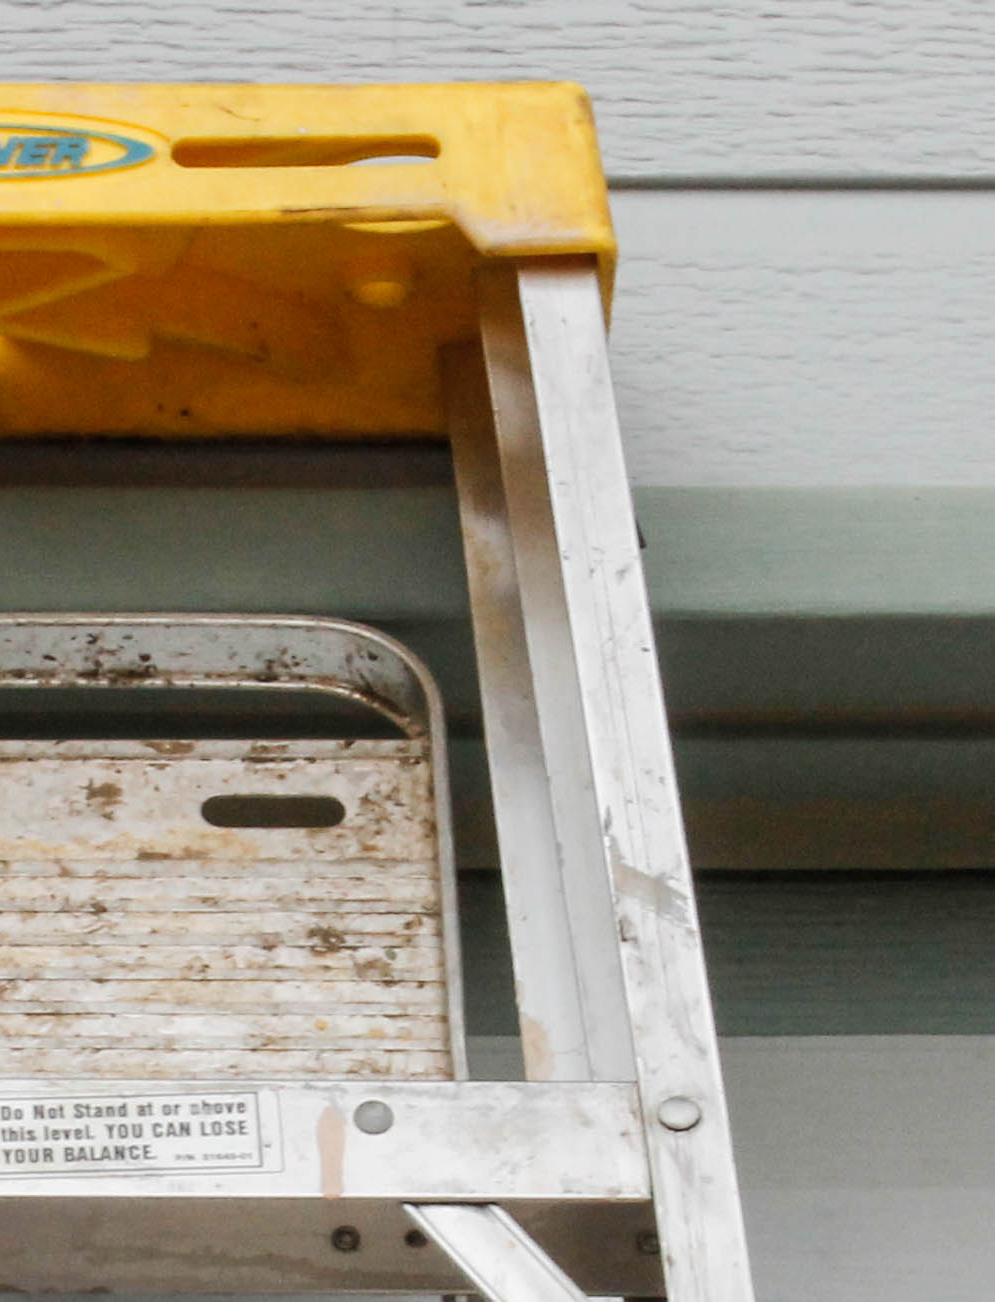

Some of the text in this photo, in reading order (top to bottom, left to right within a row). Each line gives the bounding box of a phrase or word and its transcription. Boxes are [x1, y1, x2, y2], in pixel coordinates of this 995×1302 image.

[0, 1105, 25, 1121] Do
[33, 1104, 65, 1120] Not
[73, 1102, 128, 1119] Stand
[137, 1102, 153, 1117] at
[162, 1103, 181, 1116] or
[1, 1127, 37, 1142] this
[105, 1122, 143, 1139] YOU
[152, 1121, 190, 1138] CAN
[201, 1120, 249, 1137] LOSE
[2, 1146, 54, 1164] YOUR
